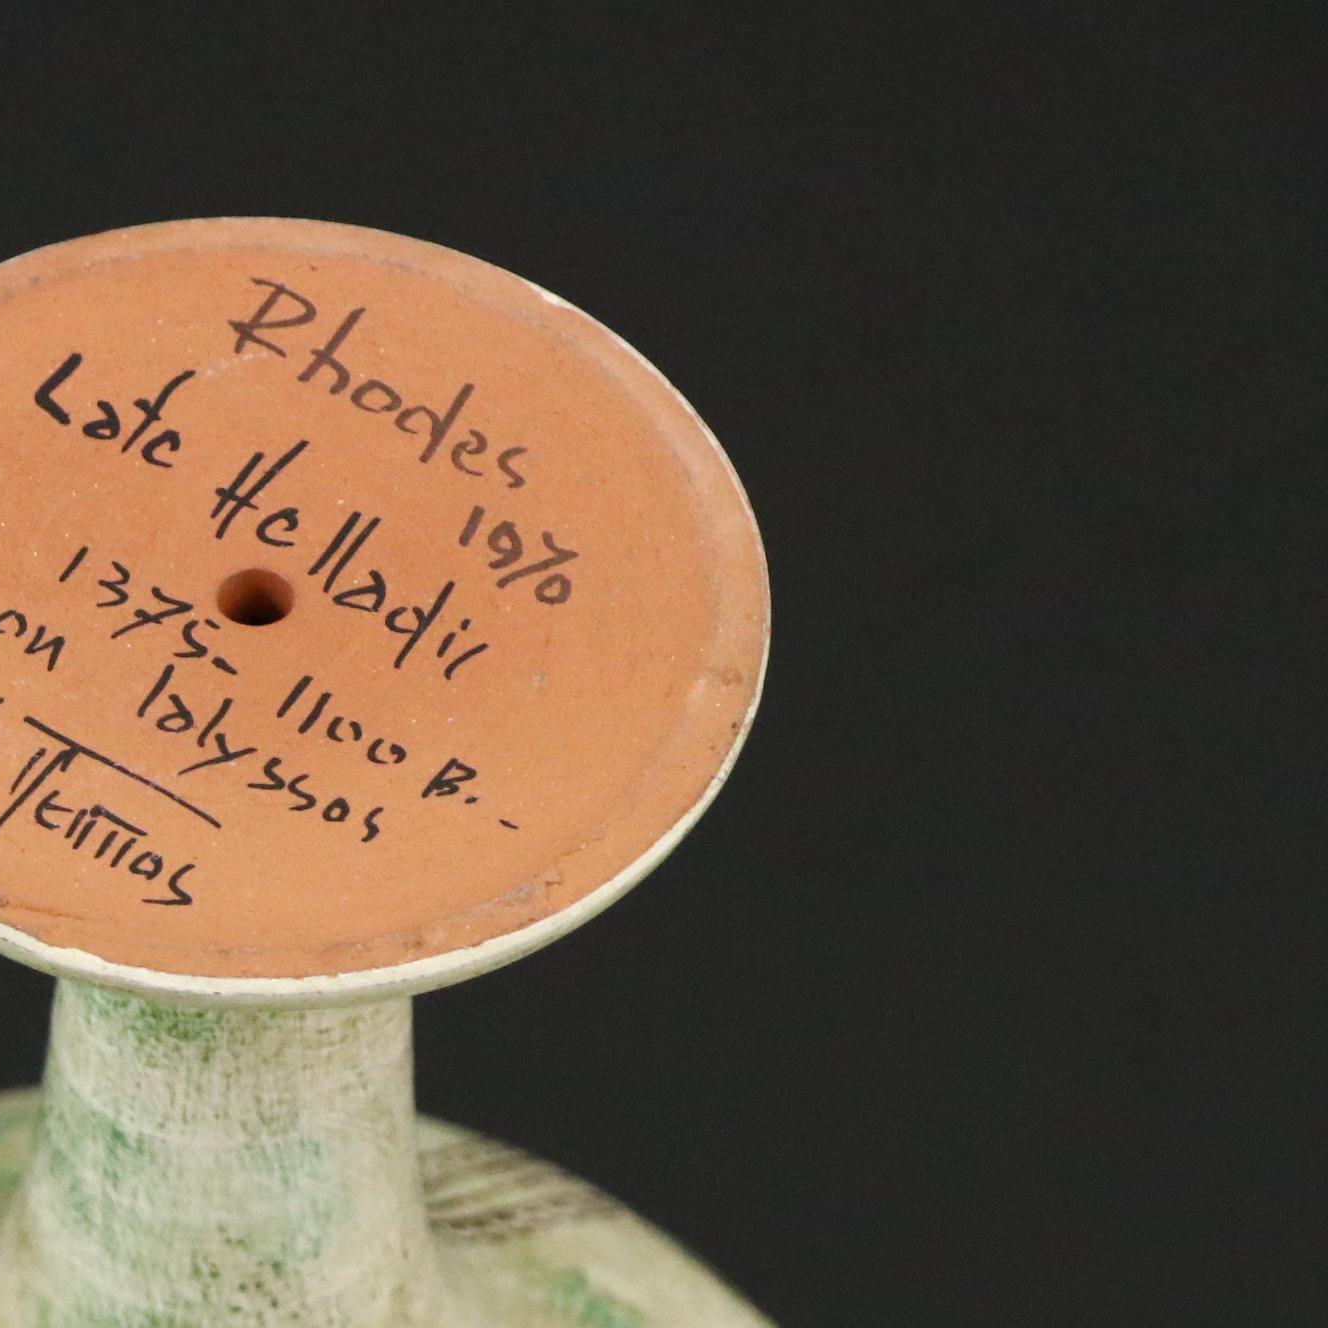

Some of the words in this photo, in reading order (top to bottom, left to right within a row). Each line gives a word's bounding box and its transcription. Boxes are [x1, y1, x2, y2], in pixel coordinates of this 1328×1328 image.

[34, 353, 196, 467] Late
[210, 440, 489, 680] Helladic
[228, 277, 528, 488] Rhodes
